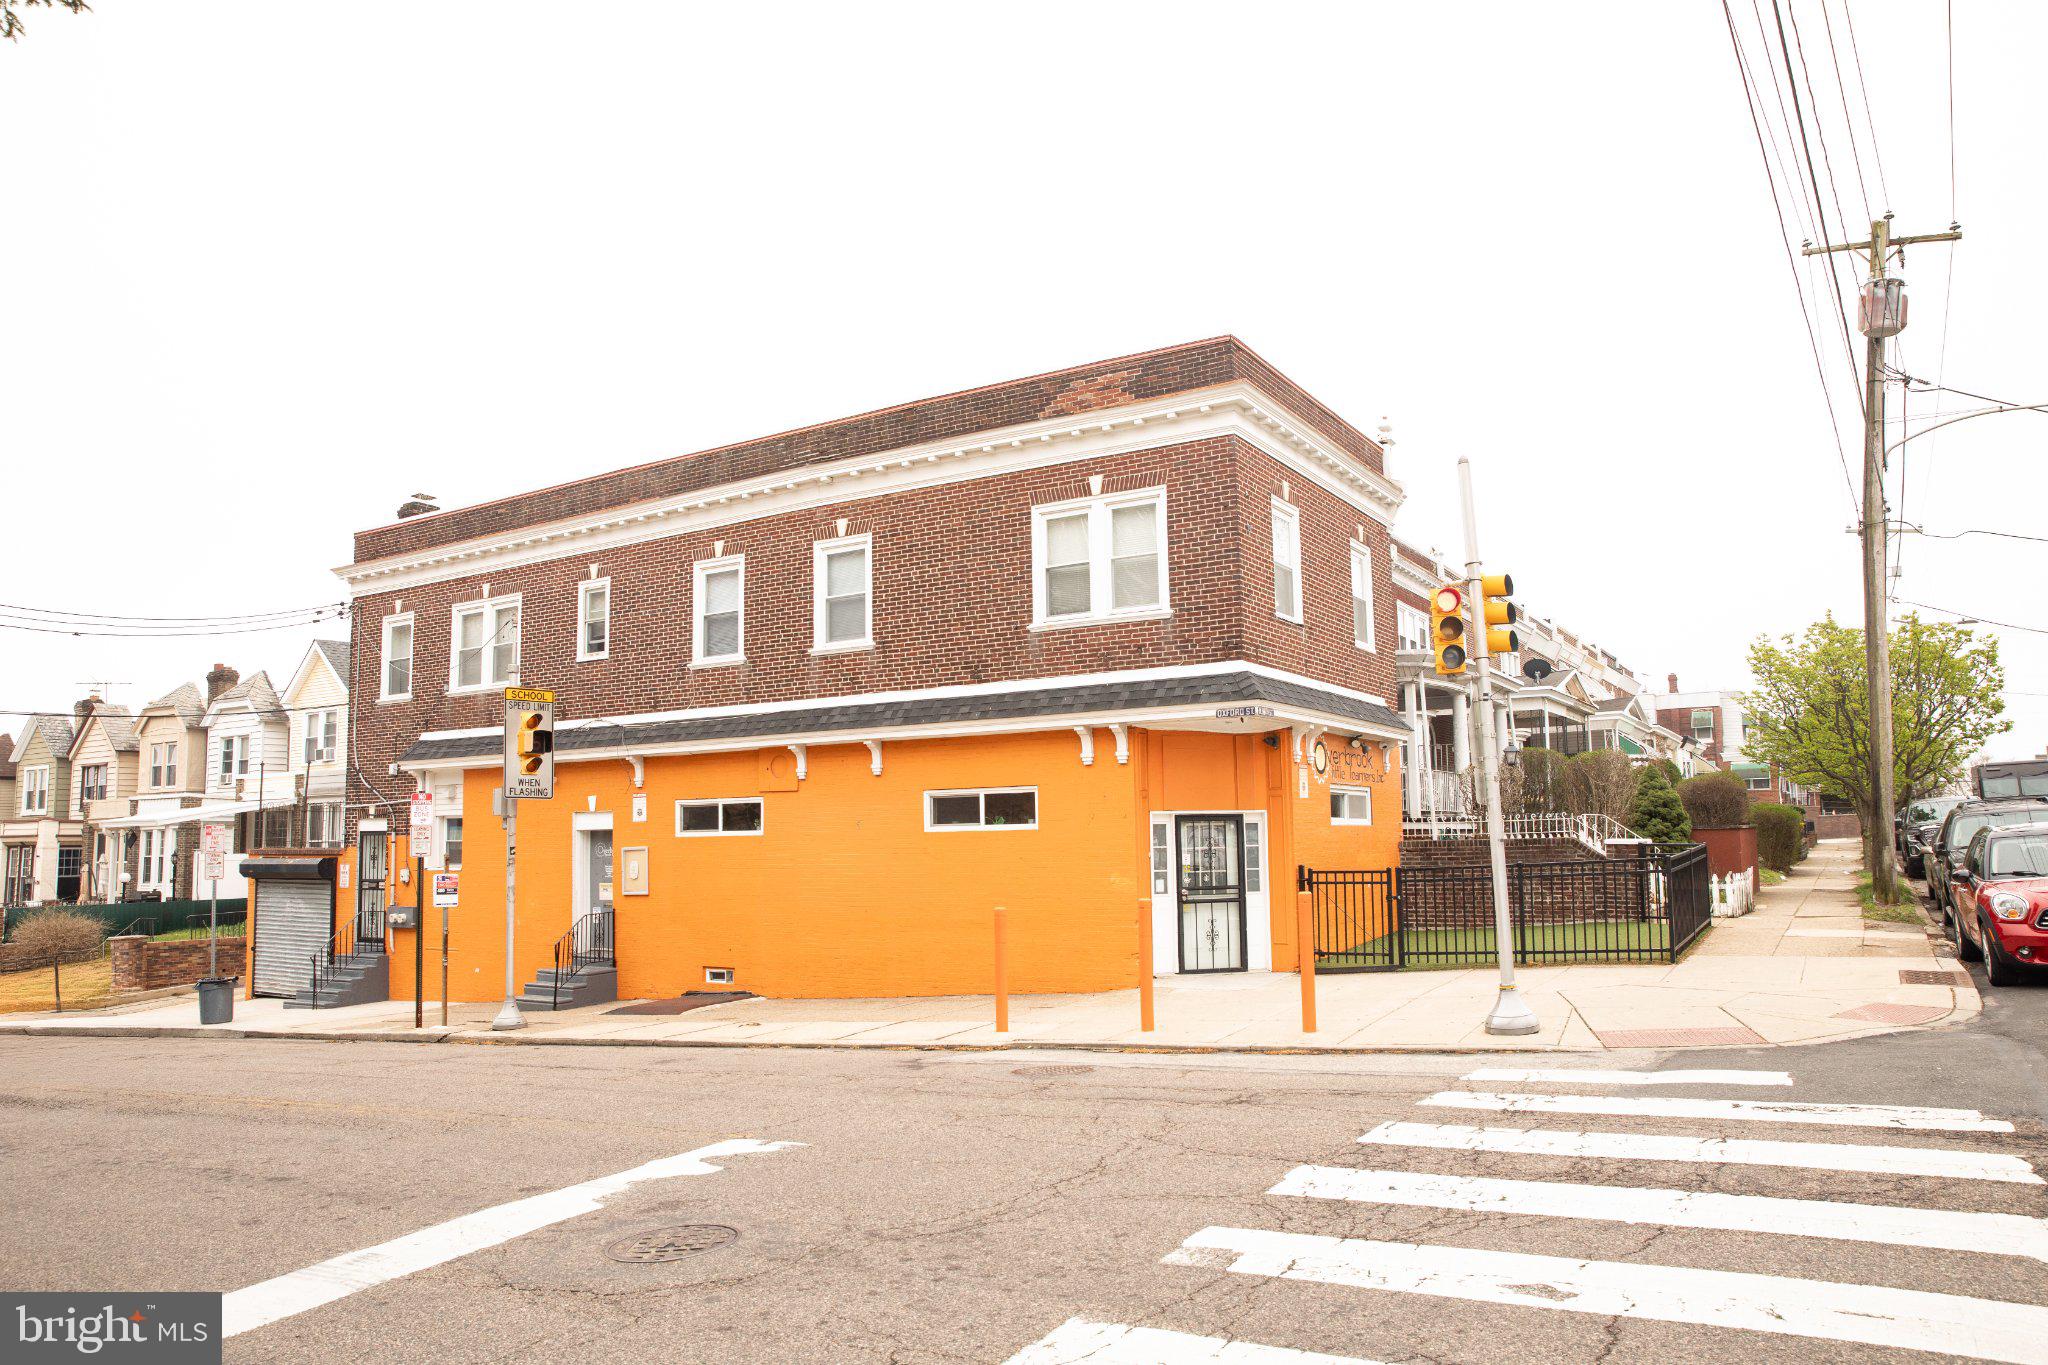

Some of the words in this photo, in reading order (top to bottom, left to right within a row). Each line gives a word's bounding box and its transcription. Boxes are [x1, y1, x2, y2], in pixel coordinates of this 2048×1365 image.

[511, 690, 548, 701] SCHOOL
[508, 700, 531, 711] SPEED
[533, 702, 551, 712] LIMIT
[1217, 707, 1245, 718] OXFORD
[518, 778, 541, 787] WHEN
[509, 788, 548, 797] FLASHING
